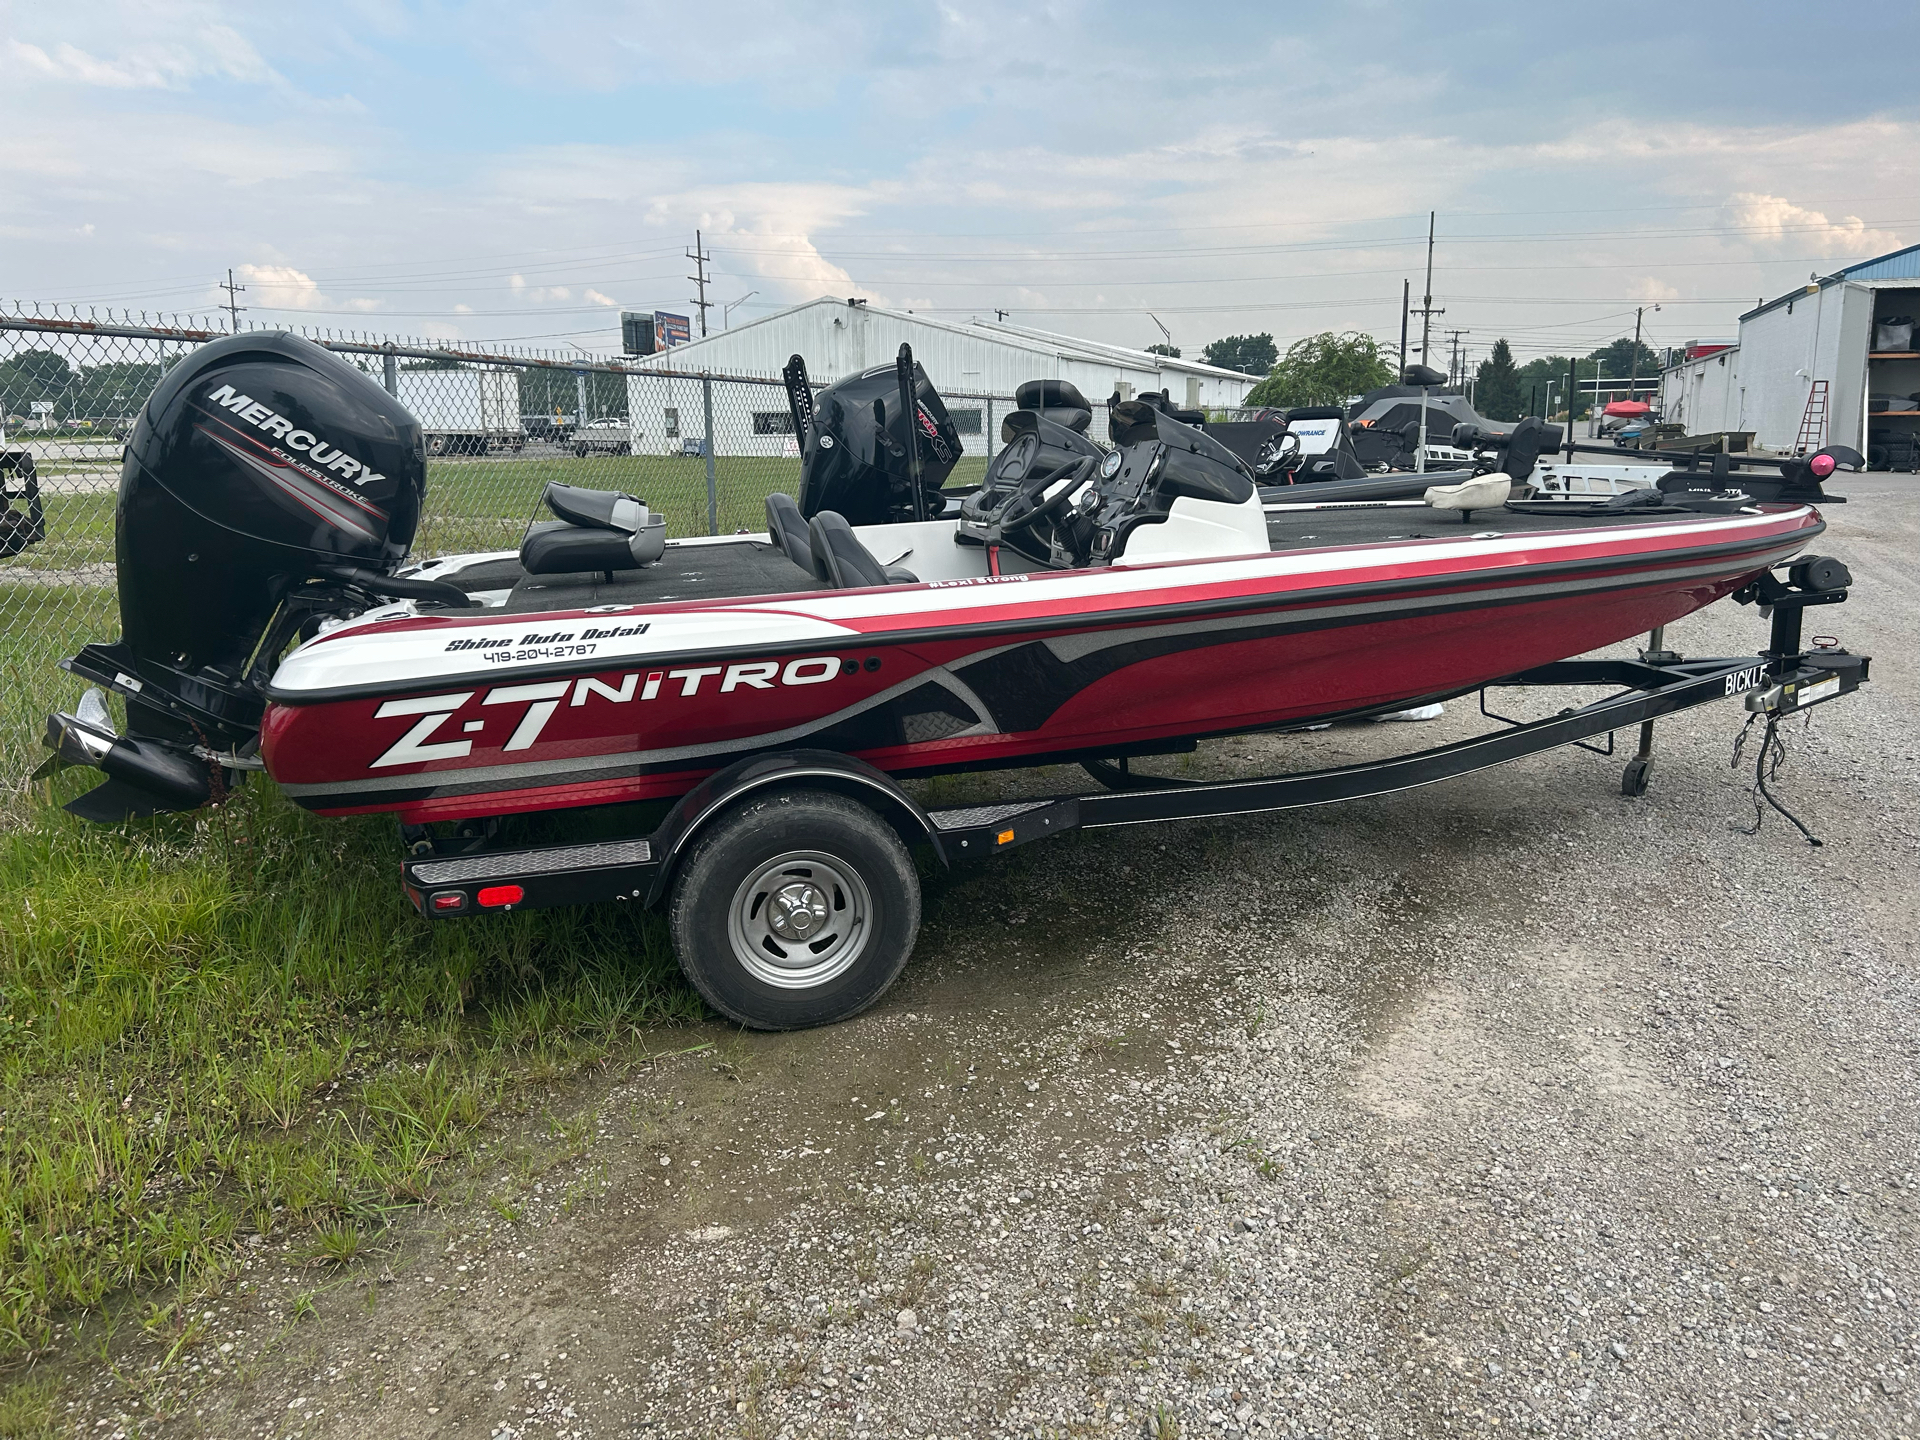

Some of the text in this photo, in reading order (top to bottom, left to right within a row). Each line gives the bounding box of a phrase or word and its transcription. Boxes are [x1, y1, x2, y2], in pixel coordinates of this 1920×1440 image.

[208, 384, 386, 486] MERCURY
[270, 446, 370, 504] FOURSTROKE
[977, 574, 1029, 584] Strong
[445, 623, 652, 651] Shine Auto Detail
[483, 643, 597, 663] 419-204-2787
